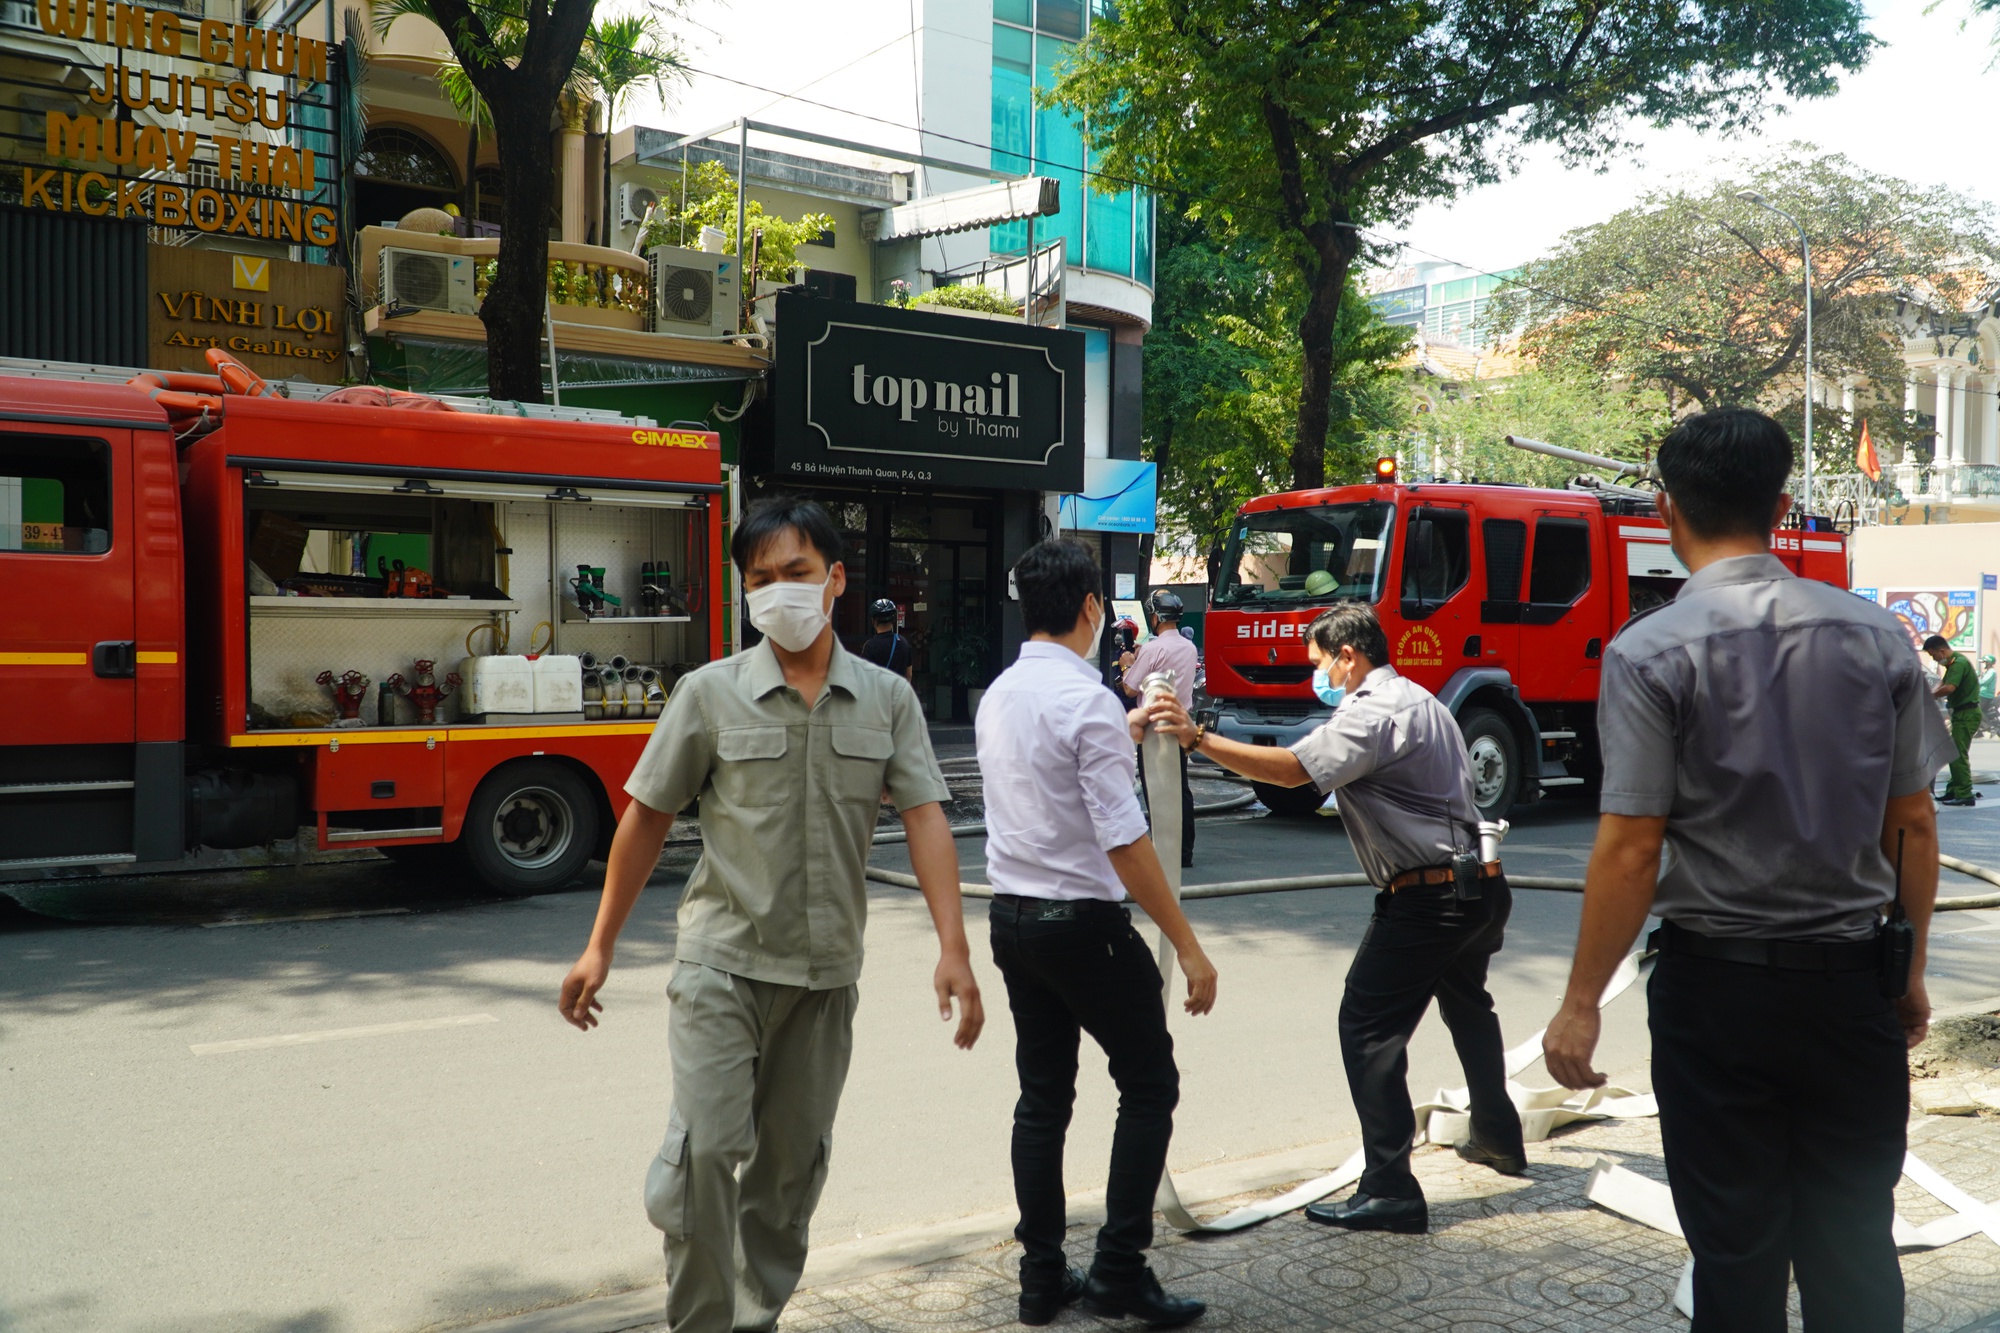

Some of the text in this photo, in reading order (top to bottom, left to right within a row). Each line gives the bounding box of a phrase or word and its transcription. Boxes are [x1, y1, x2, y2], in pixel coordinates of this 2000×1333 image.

[38, 0, 327, 83] WING CHUN
[89, 63, 287, 130] JUJITSU
[46, 110, 315, 191] MUAY THAI
[22, 166, 337, 247] KICKBOXING
[166, 330, 341, 363] Art Gallery
[851, 364, 1021, 423] top nail
[632, 430, 708, 449] GIMAEX
[938, 416, 959, 438] by
[791, 462, 801, 471] 45
[805, 463, 816, 472] Bà
[847, 466, 873, 476] Thanh
[875, 468, 899, 479] Quan,
[917, 471, 932, 480] Q.3
[24, 525, 40, 540] 39
[1237, 620, 1310, 638] sides
[1397, 630, 1412, 656] CÔNG
[1412, 625, 1423, 634] AN
[1412, 641, 1429, 654] 114
